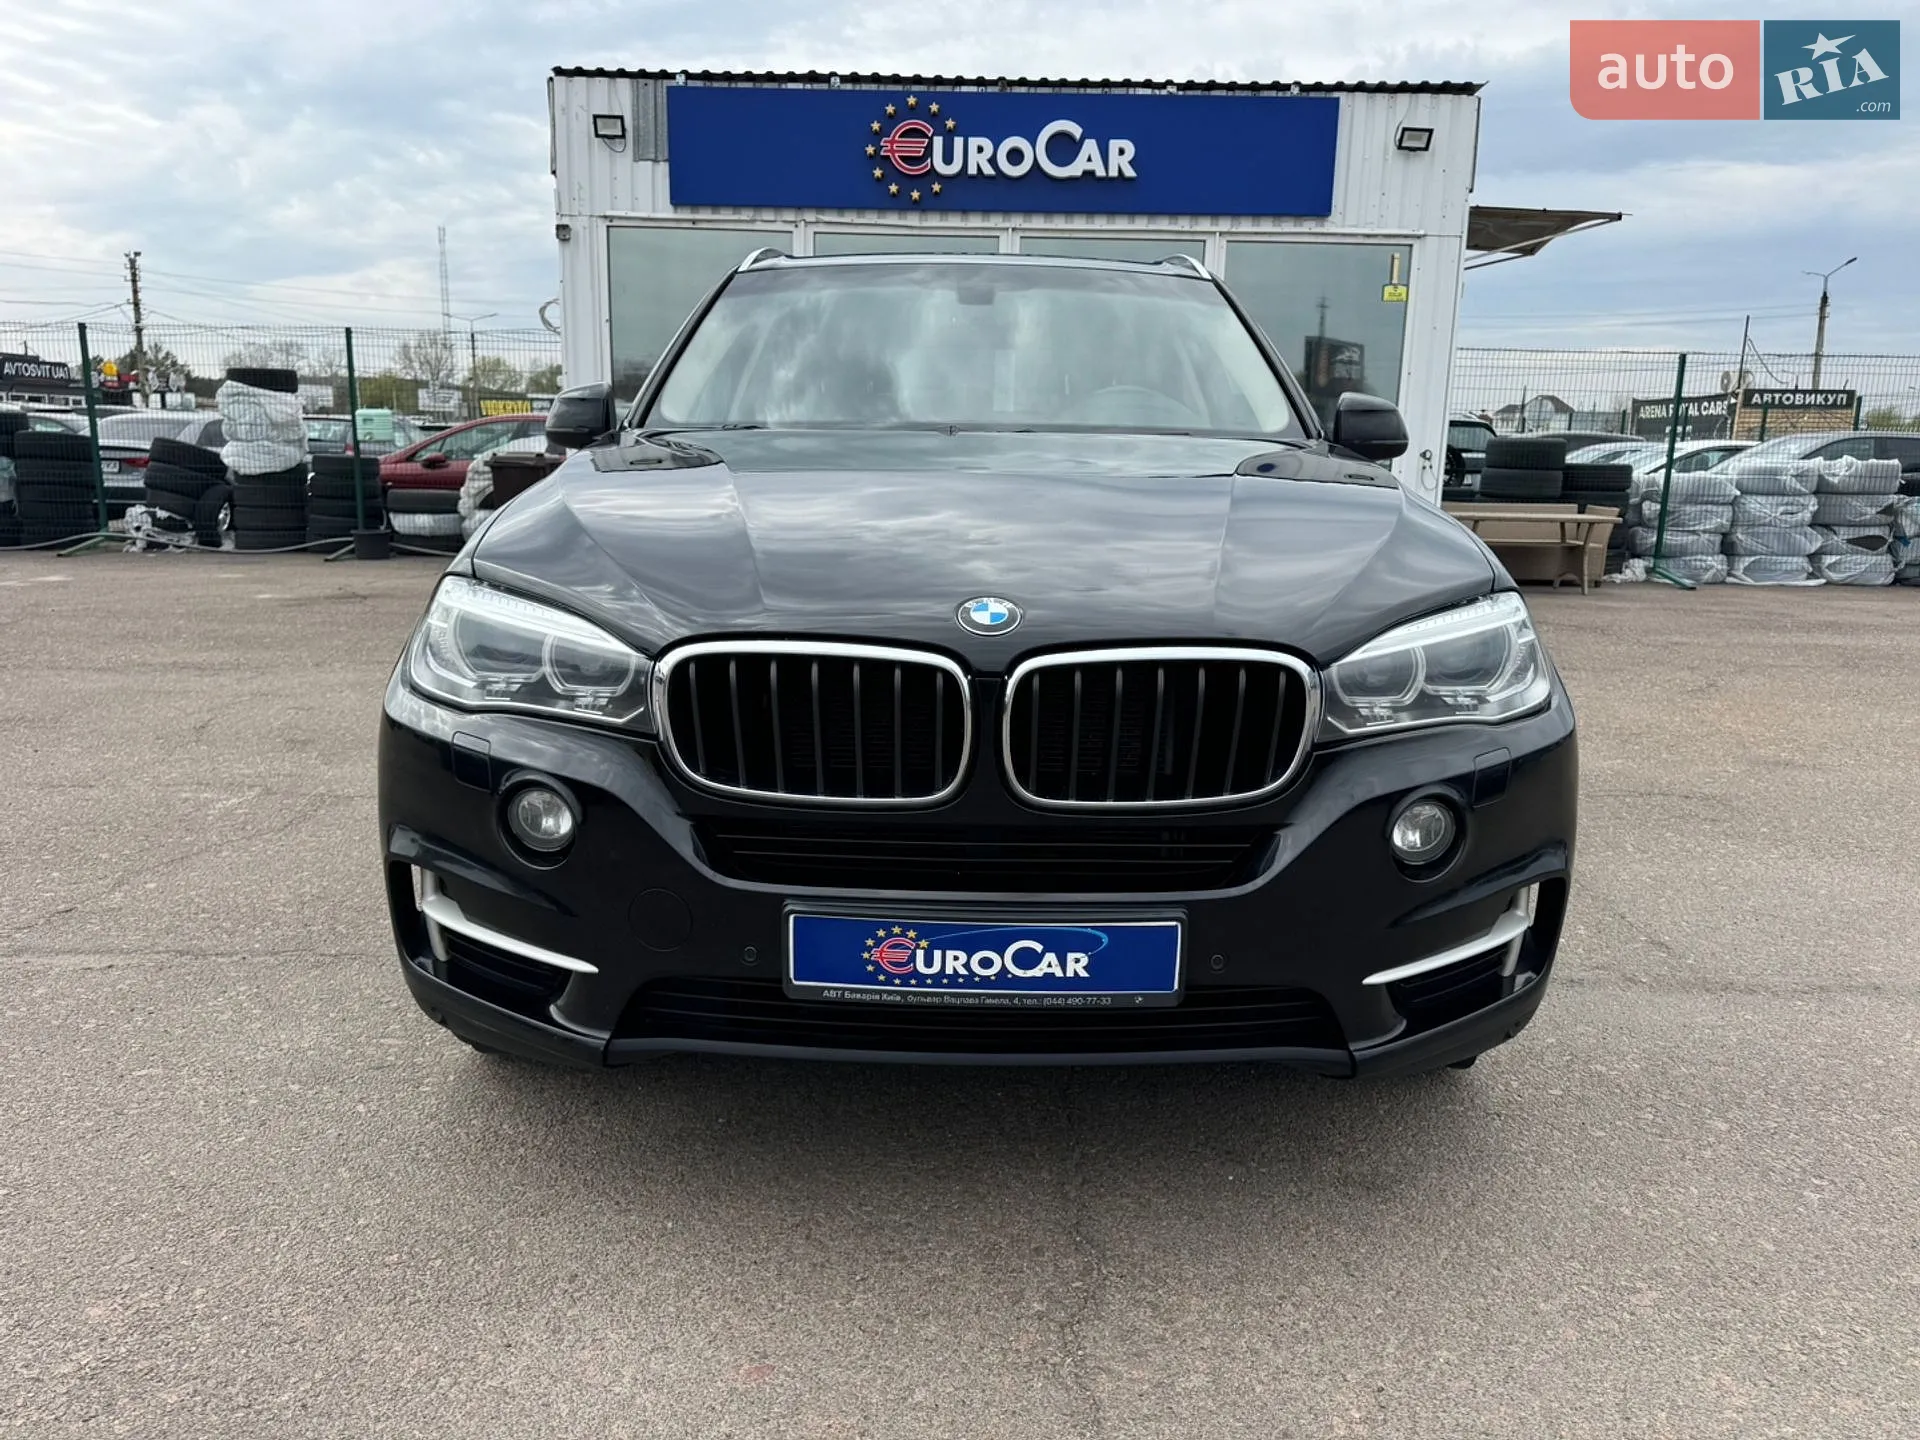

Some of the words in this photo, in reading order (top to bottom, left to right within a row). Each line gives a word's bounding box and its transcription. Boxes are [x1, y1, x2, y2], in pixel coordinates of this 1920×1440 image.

[1751, 393, 1848, 406] АВТОВИКУП
[1639, 404, 1667, 419] ARENA
[1701, 400, 1728, 417] CARS
[823, 989, 843, 998] АВТ
